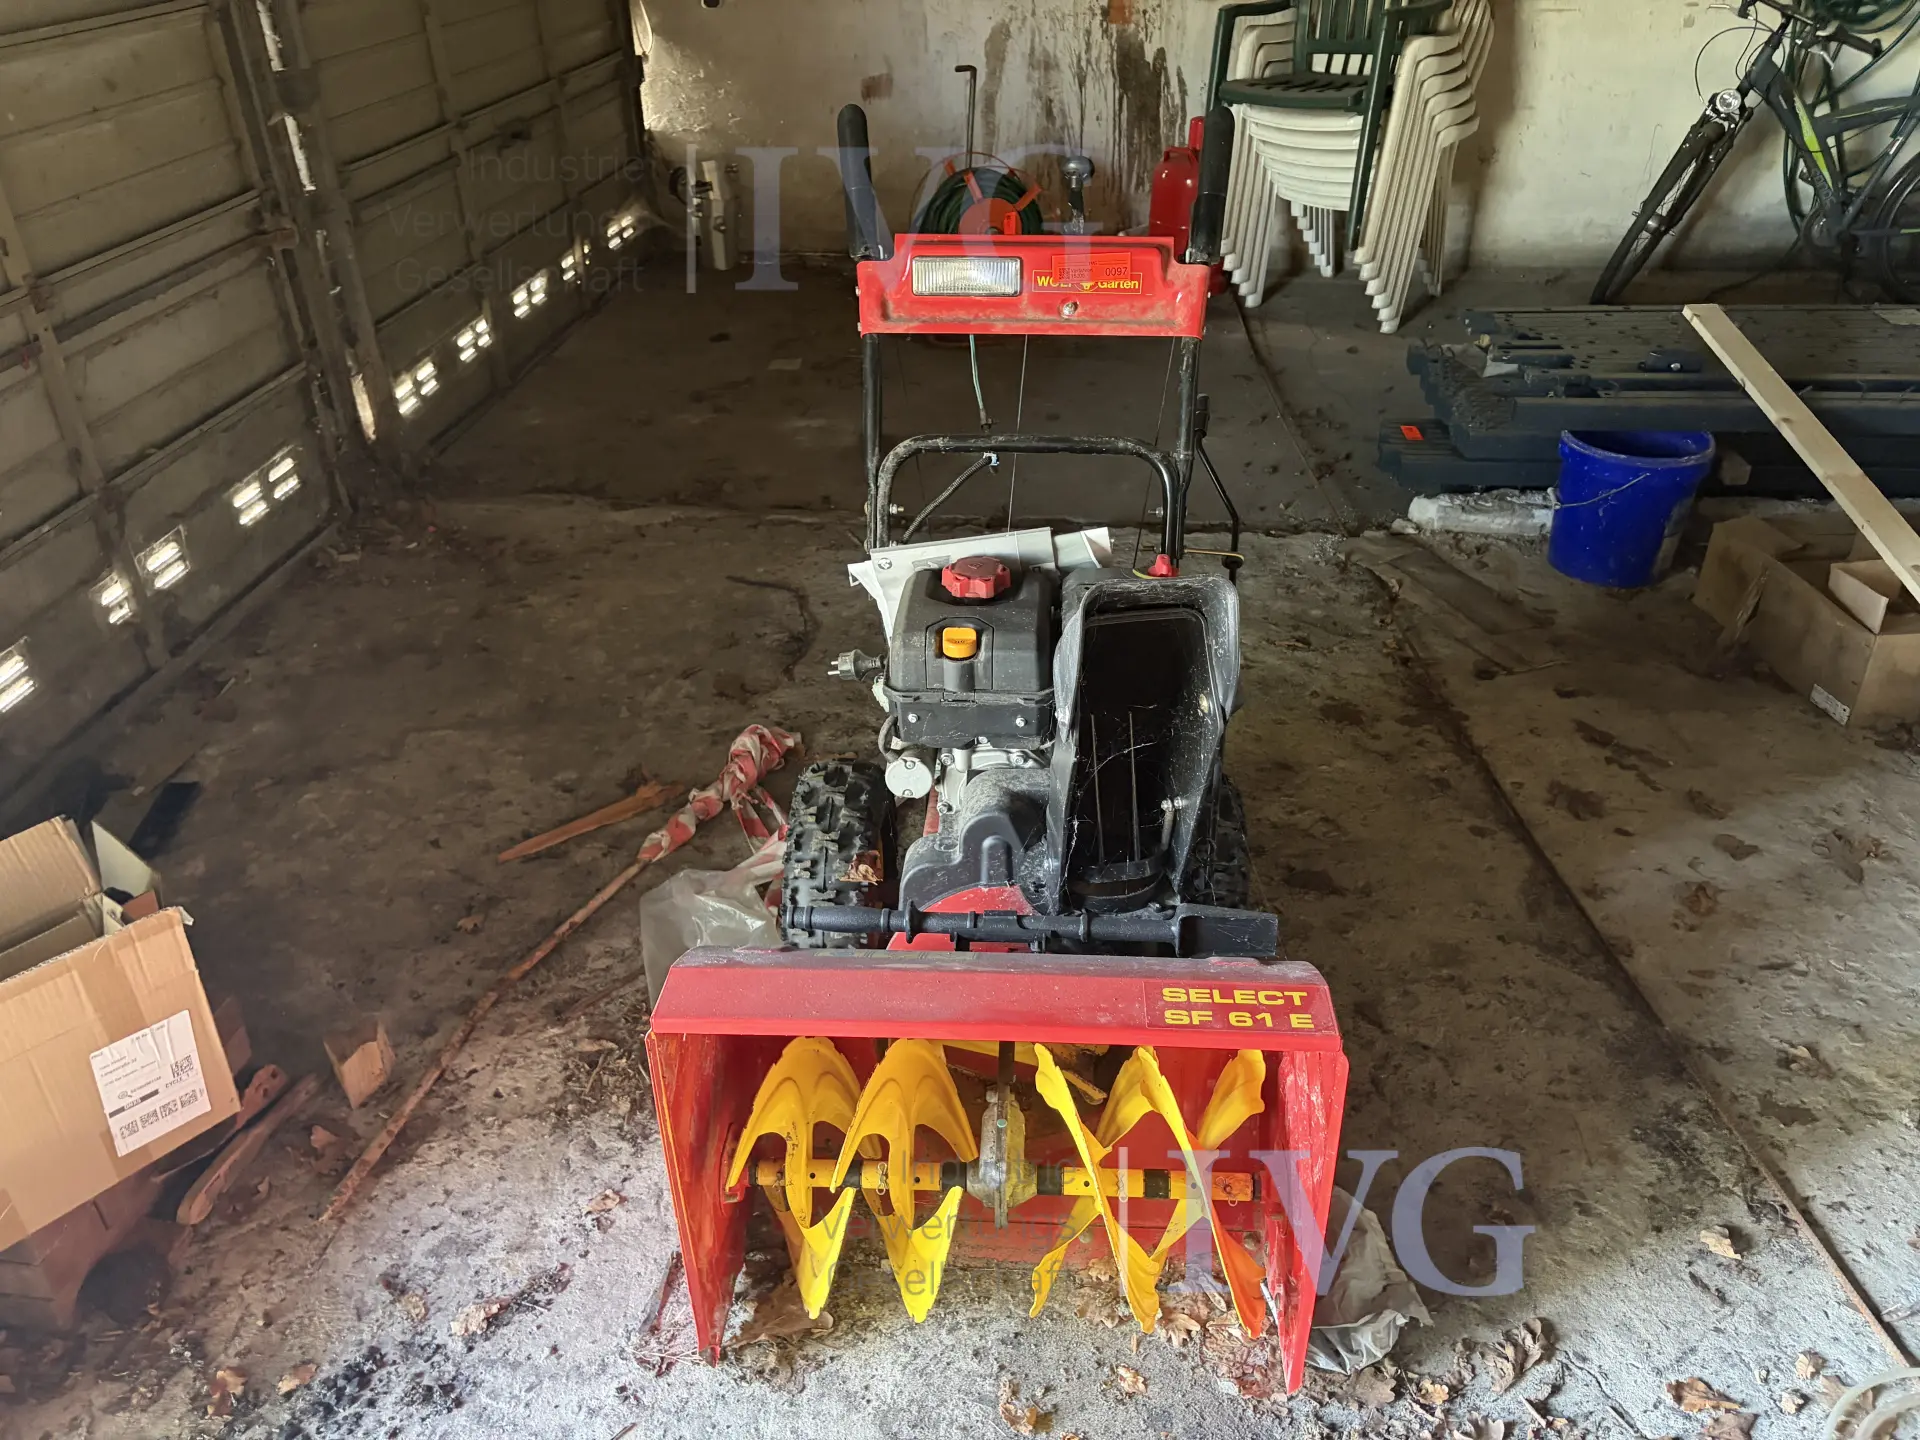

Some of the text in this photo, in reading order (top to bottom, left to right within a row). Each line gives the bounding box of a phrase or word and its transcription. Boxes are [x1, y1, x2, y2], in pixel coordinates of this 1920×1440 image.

[1105, 266, 1128, 276] 0097
[1162, 987, 1307, 1006] SELECT
[1164, 1009, 1314, 1028] SF 61 E
